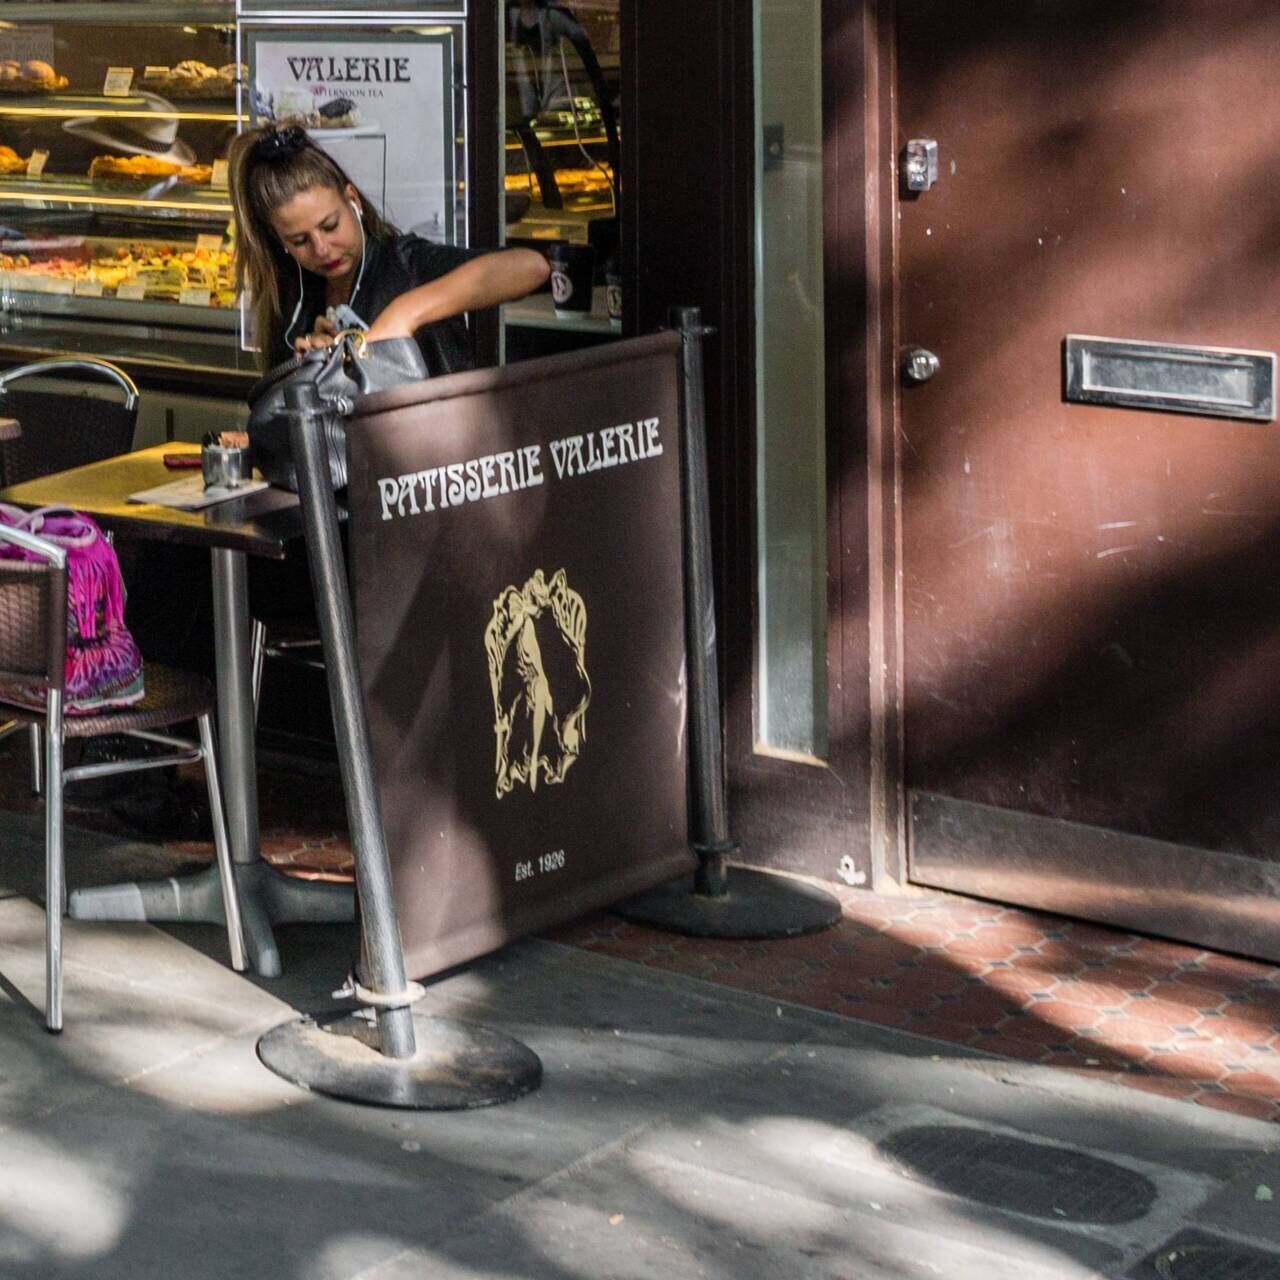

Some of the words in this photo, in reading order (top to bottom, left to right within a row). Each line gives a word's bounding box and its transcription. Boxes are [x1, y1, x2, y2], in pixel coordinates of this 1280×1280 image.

[286, 55, 412, 83] VALERIE
[313, 86, 366, 98] AFTERNOON
[368, 87, 384, 98] TEA
[378, 445, 544, 520] PATISSERIE
[550, 416, 663, 480] VALERIE
[515, 860, 534, 882] Est.
